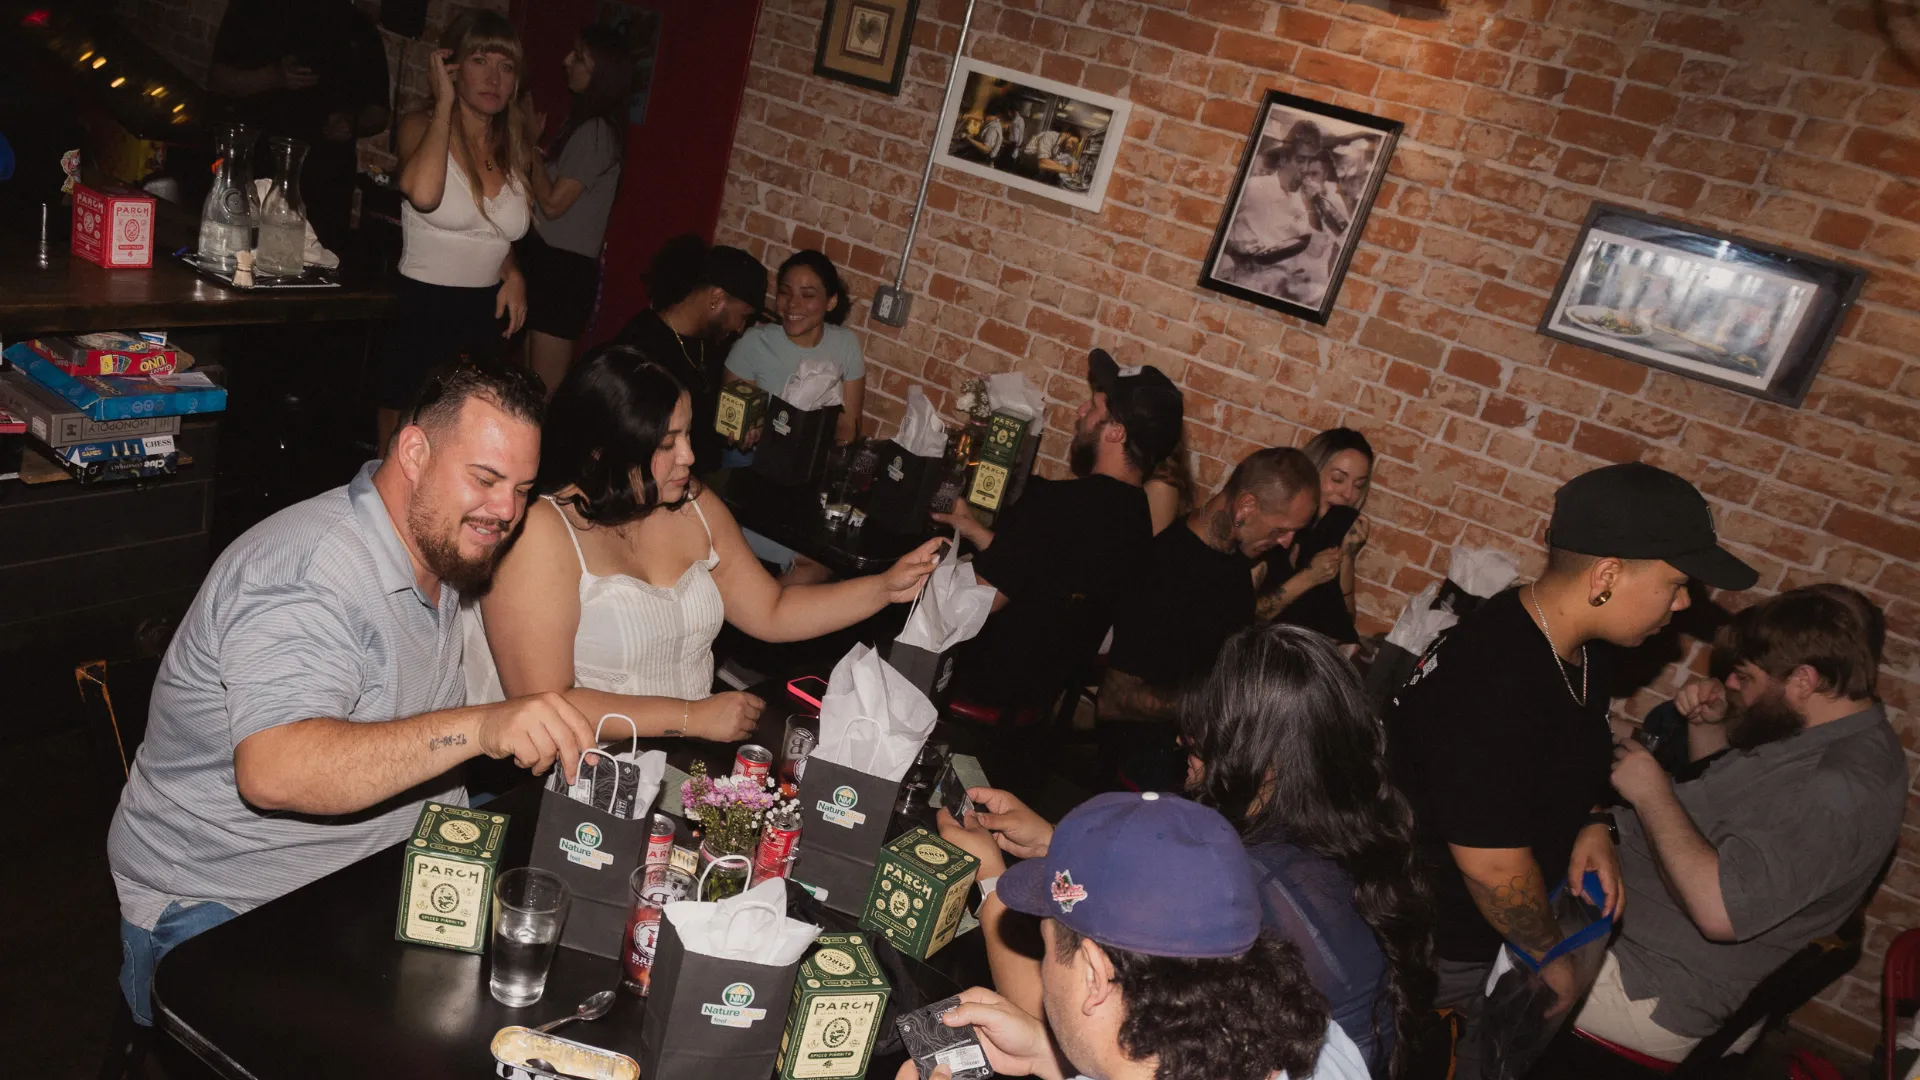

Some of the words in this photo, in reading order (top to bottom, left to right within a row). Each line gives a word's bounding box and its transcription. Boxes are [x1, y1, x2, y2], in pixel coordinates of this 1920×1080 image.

[77, 193, 104, 214] PARCH
[116, 207, 149, 217] PARCH
[129, 342, 146, 351] DOS
[139, 354, 167, 372] UNO
[150, 364, 173, 375] GIANT
[722, 395, 744, 409] PARCH
[88, 419, 149, 433] MONOPOLY
[993, 416, 1020, 432] PARCH
[145, 437, 173, 449] CHESS
[143, 459, 166, 469] Clue
[980, 464, 1006, 478] PARCH
[838, 795, 852, 805] NM
[449, 822, 471, 841] PARCH
[581, 832, 597, 844] NM
[918, 849, 945, 859] PARCH
[418, 863, 479, 883] PARCH
[883, 863, 932, 900] PARCH
[421, 914, 438, 922] SPICED
[820, 952, 850, 970] PARCH
[729, 994, 748, 1003] NM
[814, 1001, 874, 1015] PARCH
